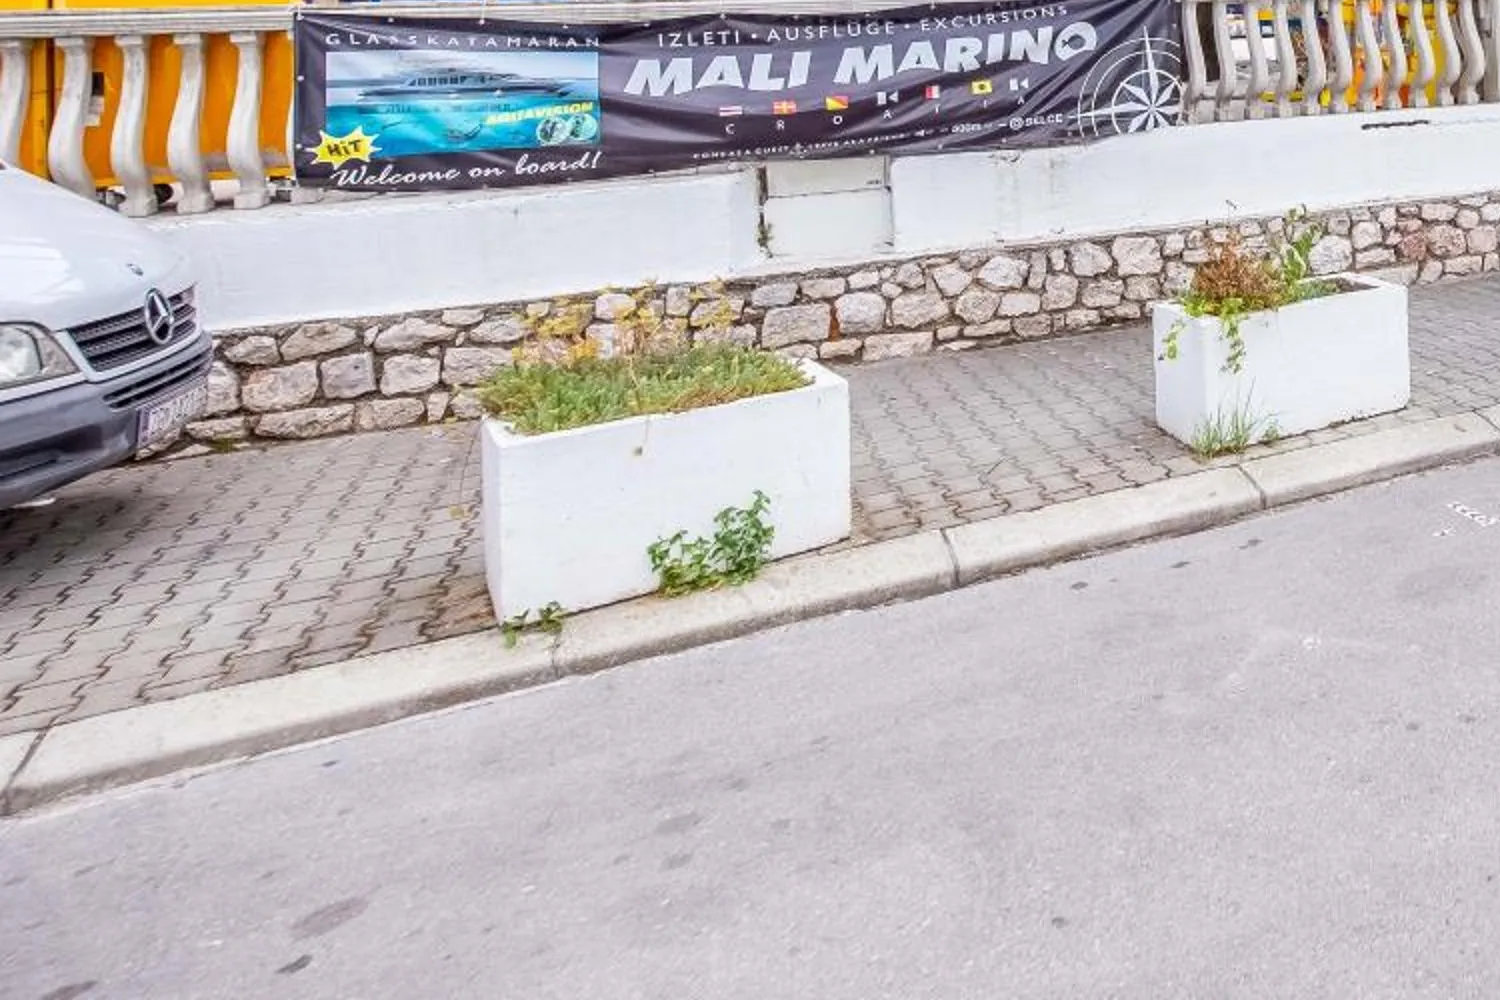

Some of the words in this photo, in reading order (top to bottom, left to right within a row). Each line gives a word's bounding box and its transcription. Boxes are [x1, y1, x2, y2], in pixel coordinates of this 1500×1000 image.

[657, 29, 740, 48] IZLETI
[920, 4, 1068, 32] EXCURSIONS
[623, 50, 813, 97] MALI
[832, 21, 1098, 85] MARINO
[329, 162, 461, 188] Welcome
[467, 165, 508, 178] on
[514, 151, 604, 176] board!
